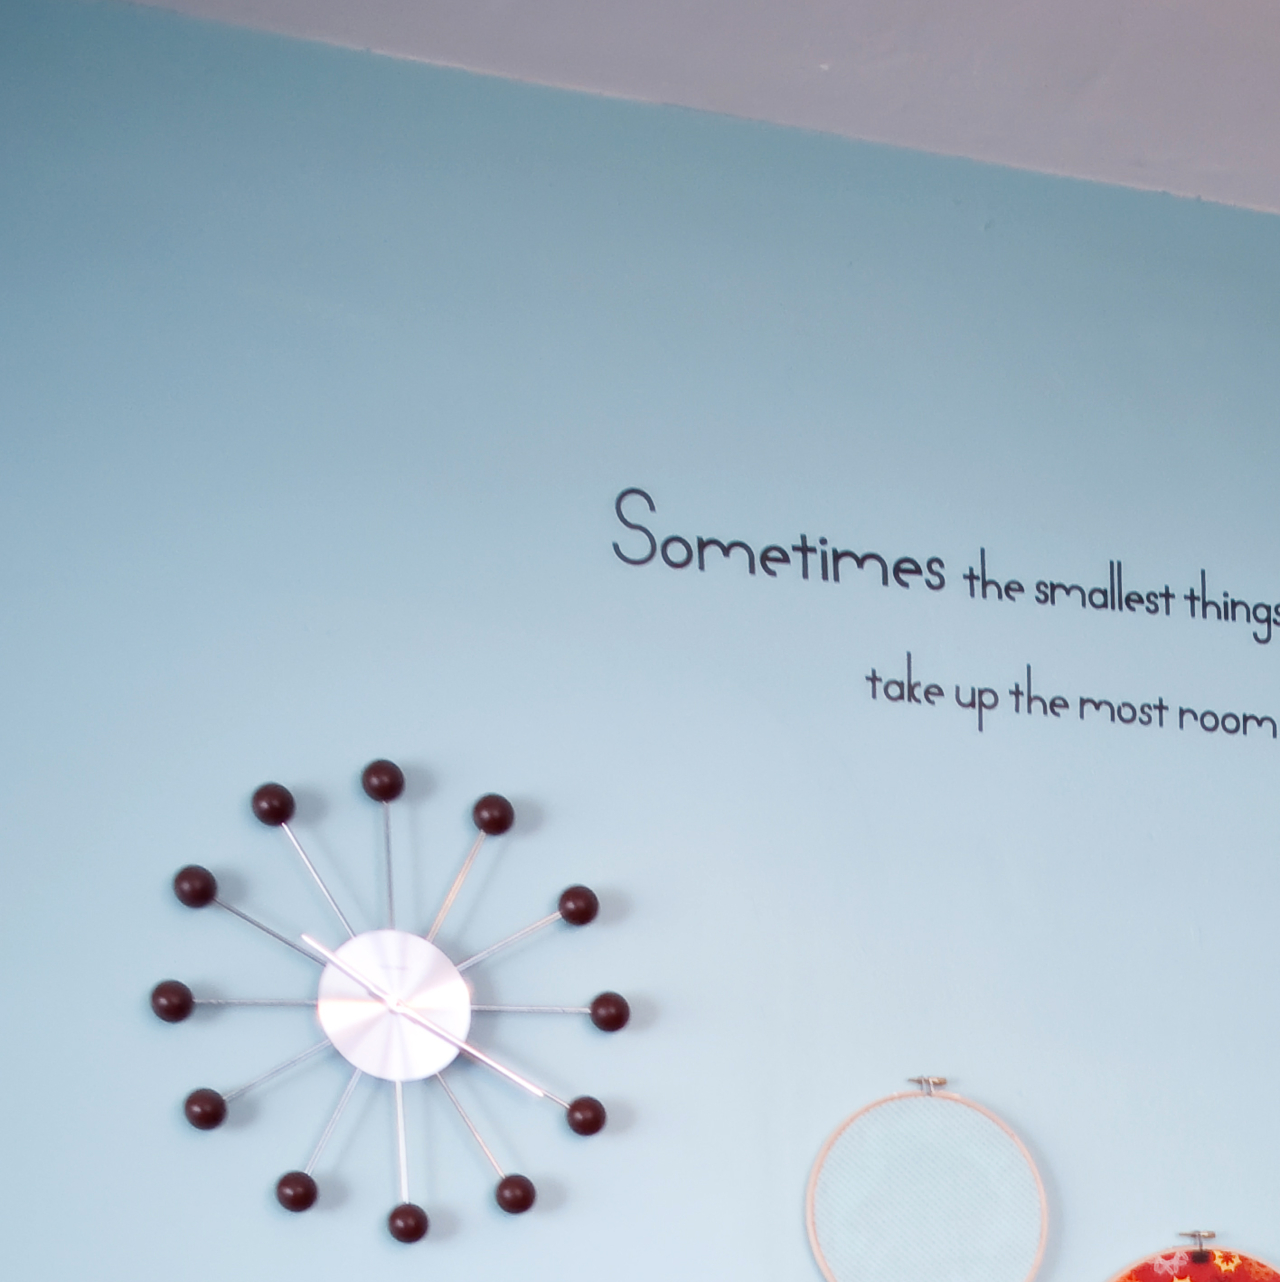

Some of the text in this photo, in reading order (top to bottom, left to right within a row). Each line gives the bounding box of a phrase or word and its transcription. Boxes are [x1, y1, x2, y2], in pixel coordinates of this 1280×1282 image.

[611, 486, 947, 593] Sometimes
[961, 546, 1026, 606] the
[1033, 559, 1177, 619] smallest
[864, 650, 946, 707] take
[953, 684, 1001, 734] up
[1007, 663, 1071, 719] the
[1078, 694, 1171, 729] most
[1177, 704, 1279, 740] room
